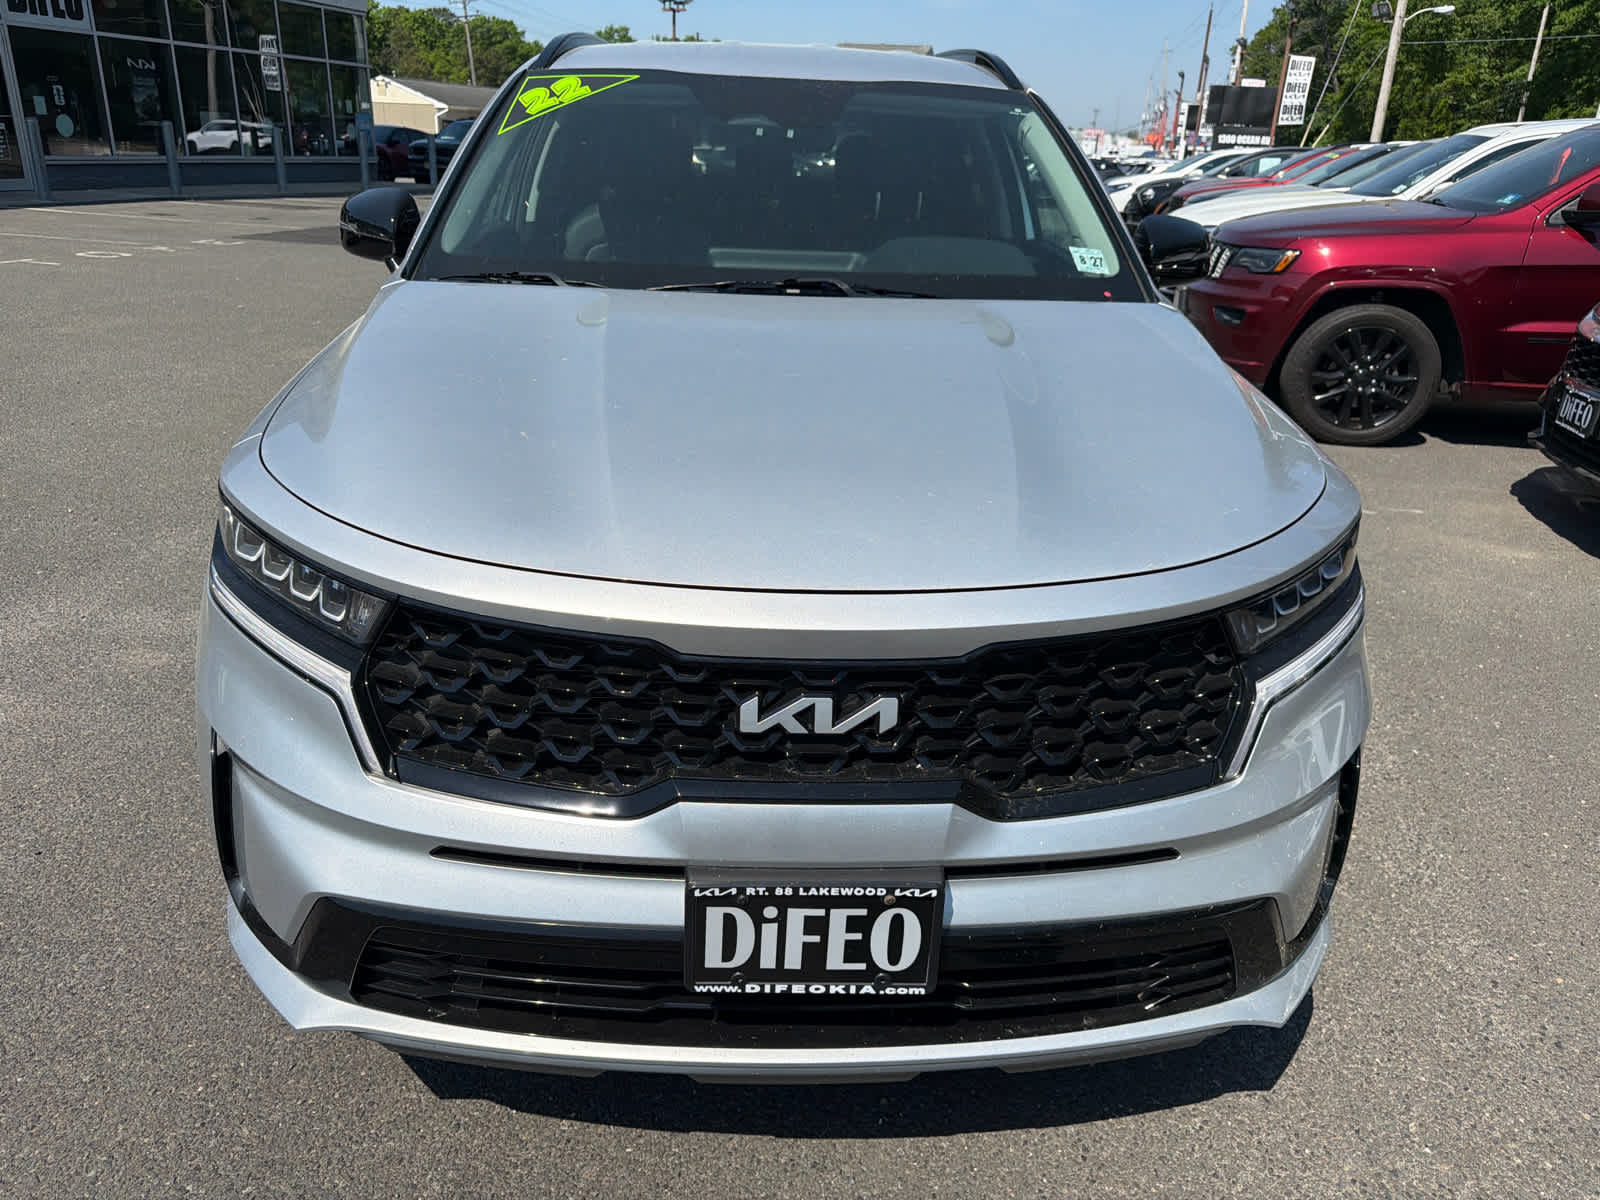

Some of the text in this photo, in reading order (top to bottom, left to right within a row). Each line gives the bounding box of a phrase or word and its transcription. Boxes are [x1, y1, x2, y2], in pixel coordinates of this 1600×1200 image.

[519, 77, 591, 114] 22
[1236, 135, 1260, 145] OCEAN
[1090, 256, 1103, 267] 27
[1560, 394, 1592, 428] DiFEO
[740, 696, 898, 734] KIA
[694, 887, 938, 898] KIA RT. 88 LAKEWOOD KIA
[704, 906, 922, 972] DiFEO
[694, 984, 926, 995] www.DIFEOKIA.com
